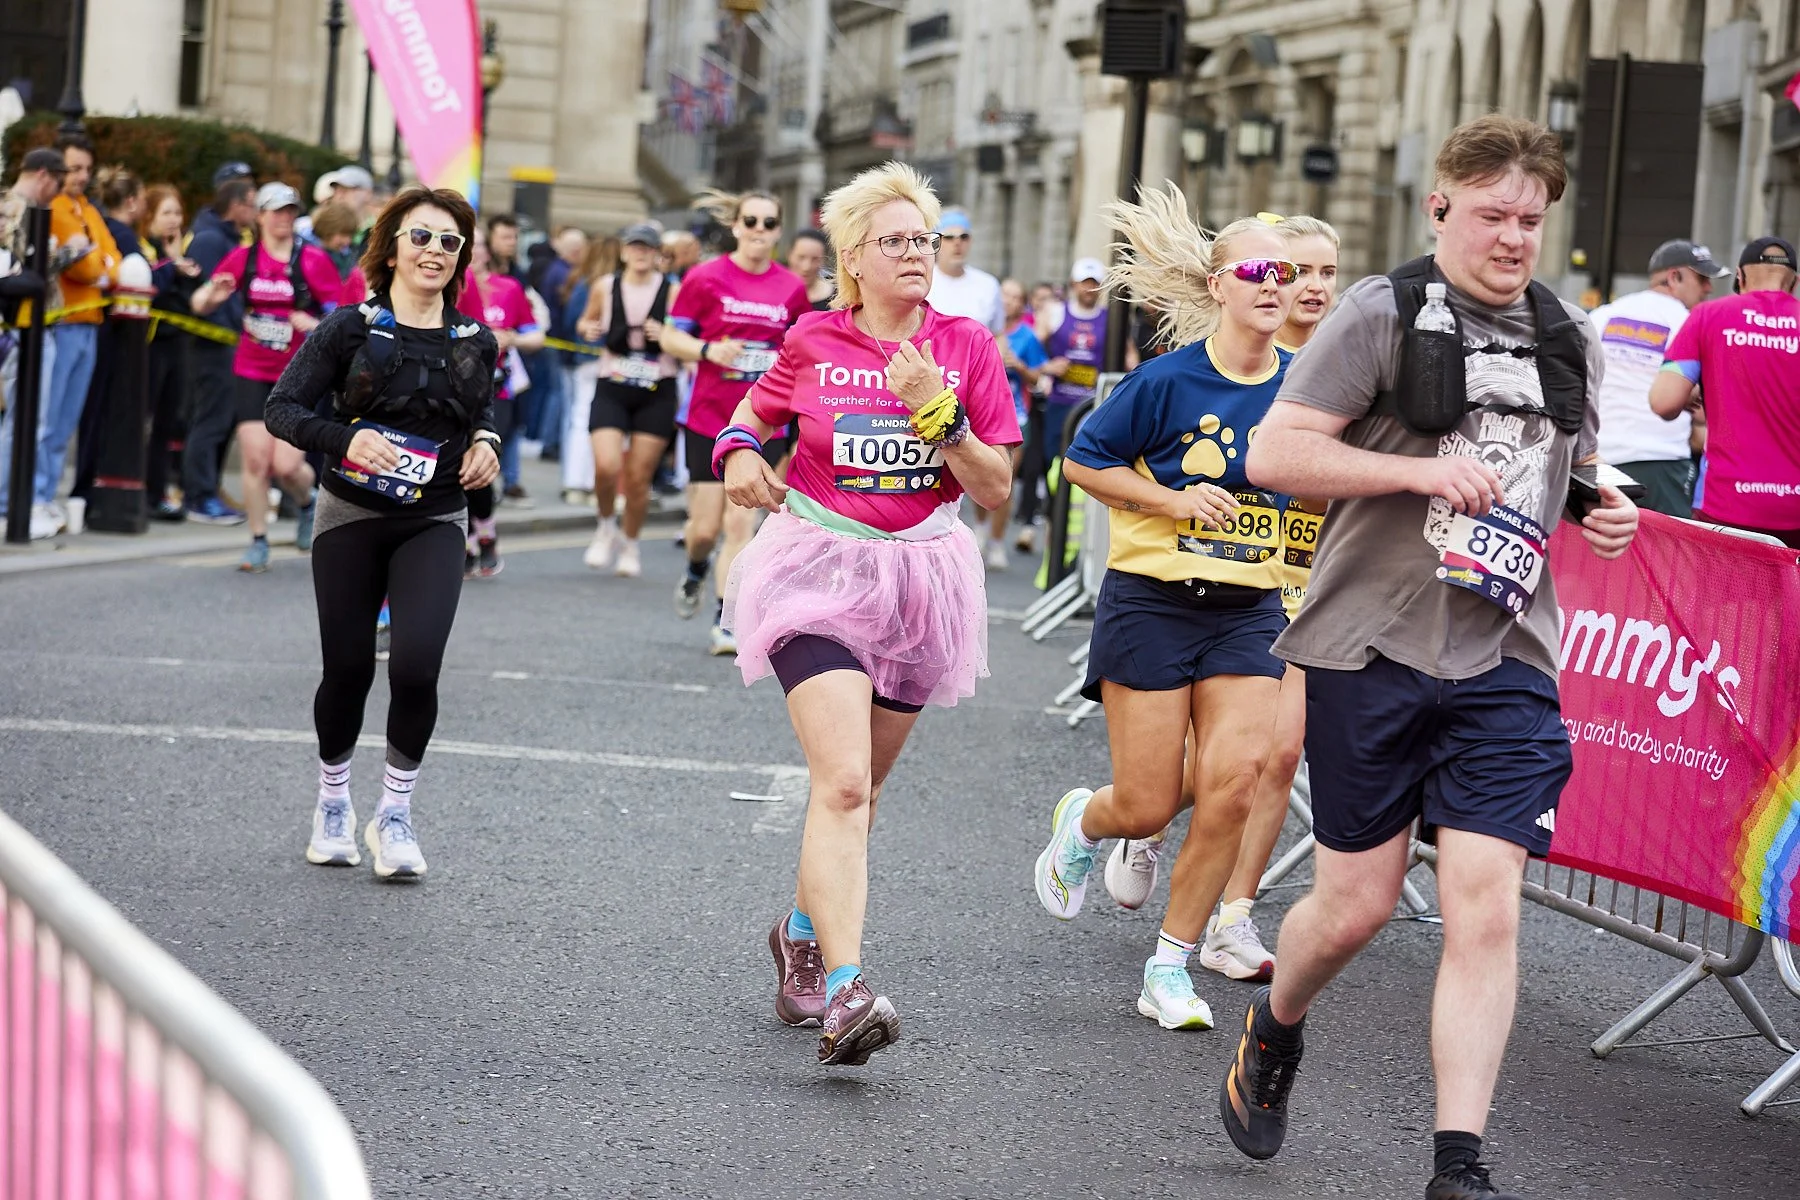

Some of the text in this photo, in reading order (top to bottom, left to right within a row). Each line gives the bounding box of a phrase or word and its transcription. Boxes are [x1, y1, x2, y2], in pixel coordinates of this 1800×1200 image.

[1742, 308, 1797, 330] Team
[818, 395, 872, 407] Together,
[875, 397, 893, 407] for
[871, 418, 912, 429] SANDRA
[382, 430, 408, 444] MARY
[842, 437, 939, 466] 10057
[1230, 492, 1258, 503] OTTE
[1489, 505, 1522, 530] ICHAEL
[1467, 525, 1535, 582] 8739
[1560, 716, 1730, 781] cy and baby charity
